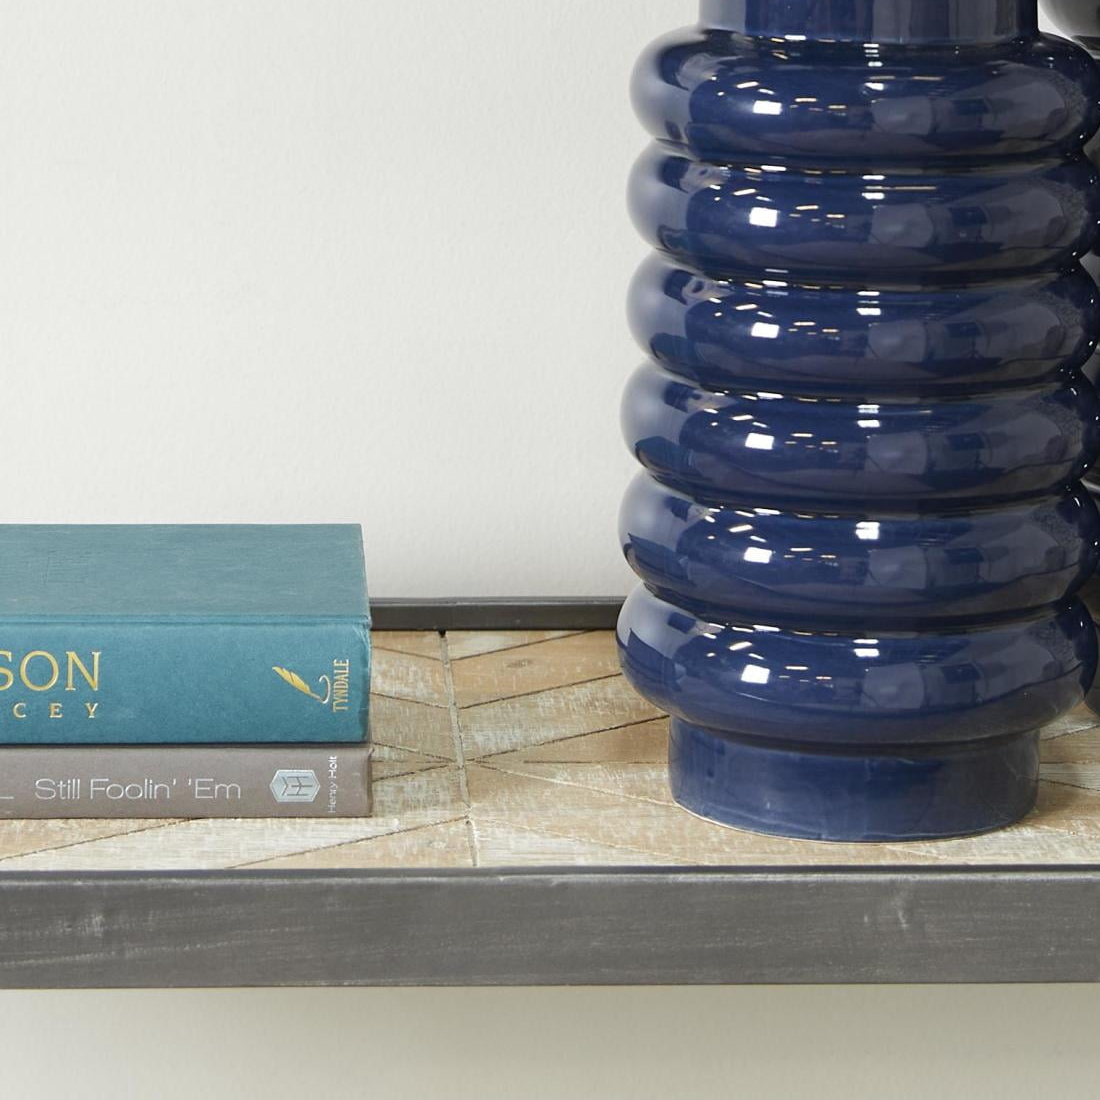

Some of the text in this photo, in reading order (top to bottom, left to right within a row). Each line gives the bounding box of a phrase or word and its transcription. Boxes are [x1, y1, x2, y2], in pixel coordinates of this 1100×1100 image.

[333, 659, 349, 712] TYNDALE
[35, 778, 241, 800] Still Foolin' 'Em
[328, 755, 338, 813] Henry Holt
